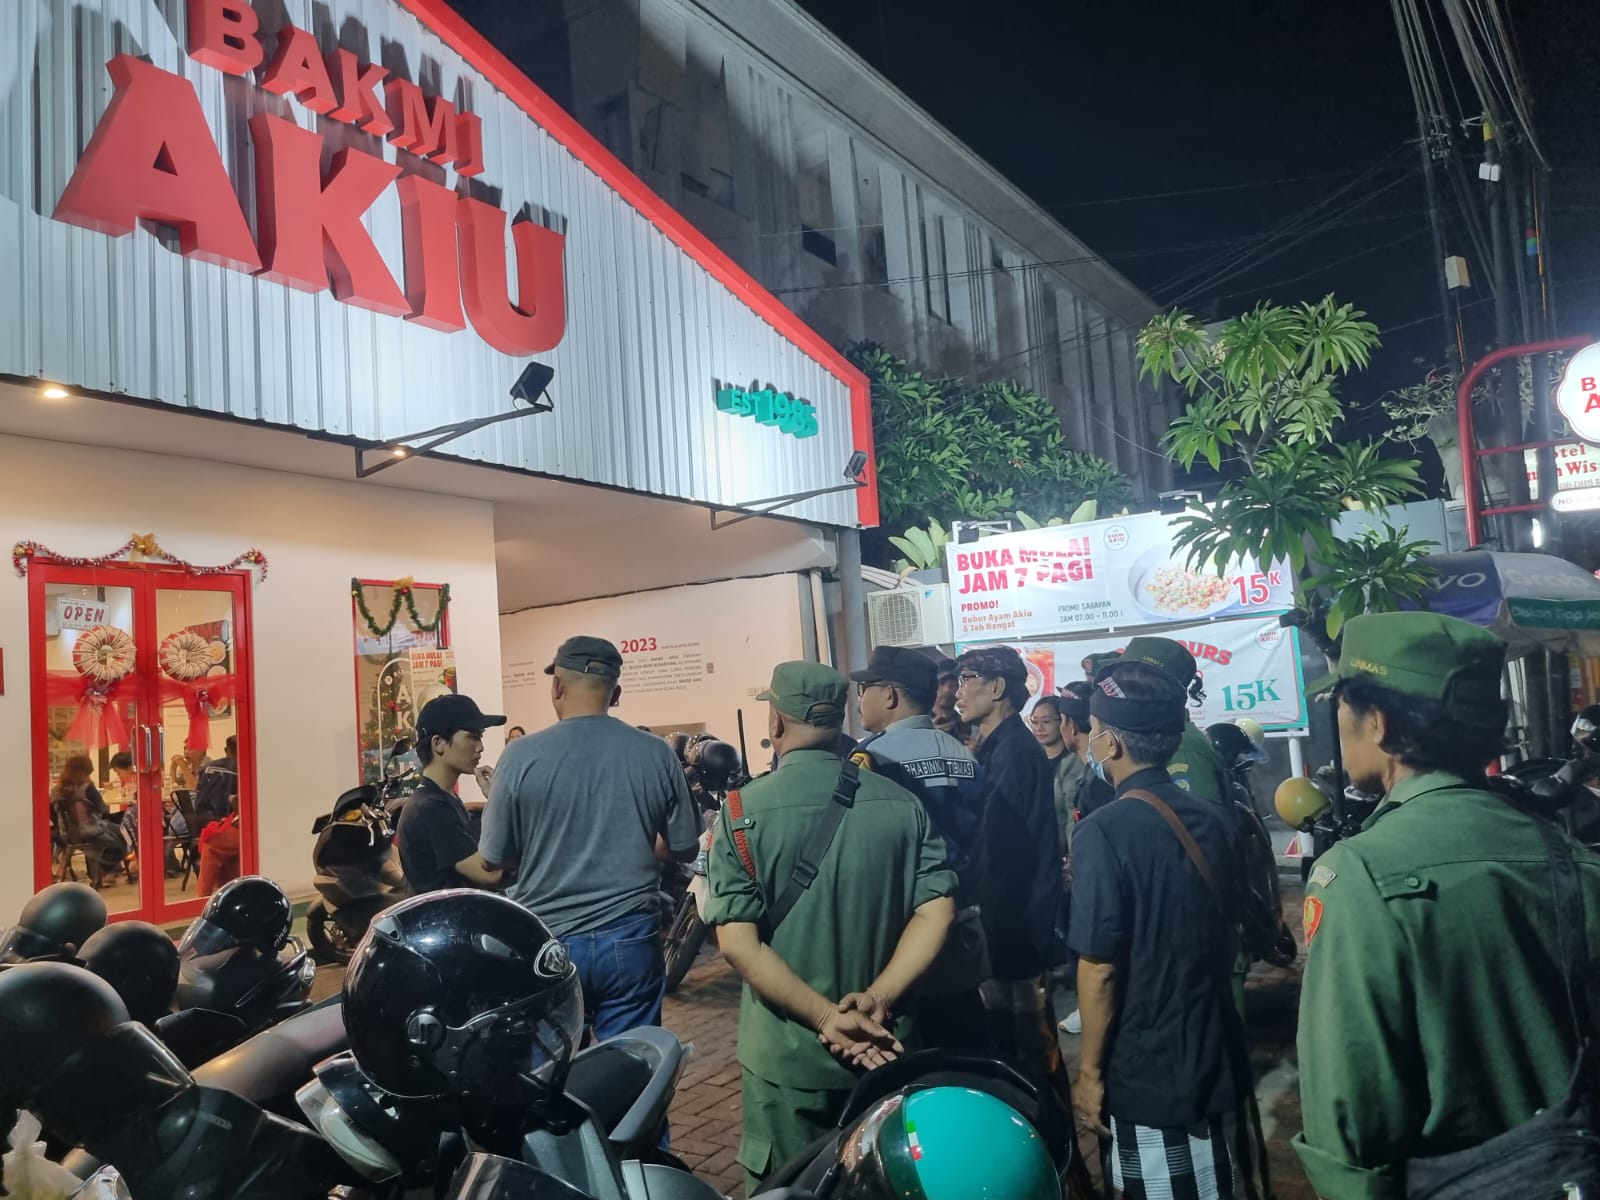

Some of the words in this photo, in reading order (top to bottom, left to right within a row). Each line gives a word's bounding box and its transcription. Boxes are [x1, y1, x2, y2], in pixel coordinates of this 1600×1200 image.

[187, 0, 484, 177] BAKMI
[52, 53, 567, 357] AKIU
[715, 387, 761, 420] EST
[957, 548, 1014, 571] BUKA
[959, 570, 1009, 594] JAM
[1015, 567, 1028, 588] 7
[1036, 558, 1094, 584] PAGI
[1431, 573, 1487, 590] VO
[1504, 569, 1589, 588] Grab
[1232, 571, 1281, 606] 15K
[64, 605, 104, 622] OPEN
[961, 600, 999, 612] PROMO!
[1058, 603, 1080, 613] PROMO
[1081, 600, 1112, 610] SARAPAN
[962, 614, 987, 624] Bubur
[988, 613, 1011, 623] Ayam
[1013, 610, 1033, 619] Akiu
[970, 624, 985, 632] Teh
[986, 620, 1015, 632] Hangat
[1059, 615, 1074, 624] JAM
[621, 637, 657, 654] 2023
[1221, 678, 1281, 711] 15K
